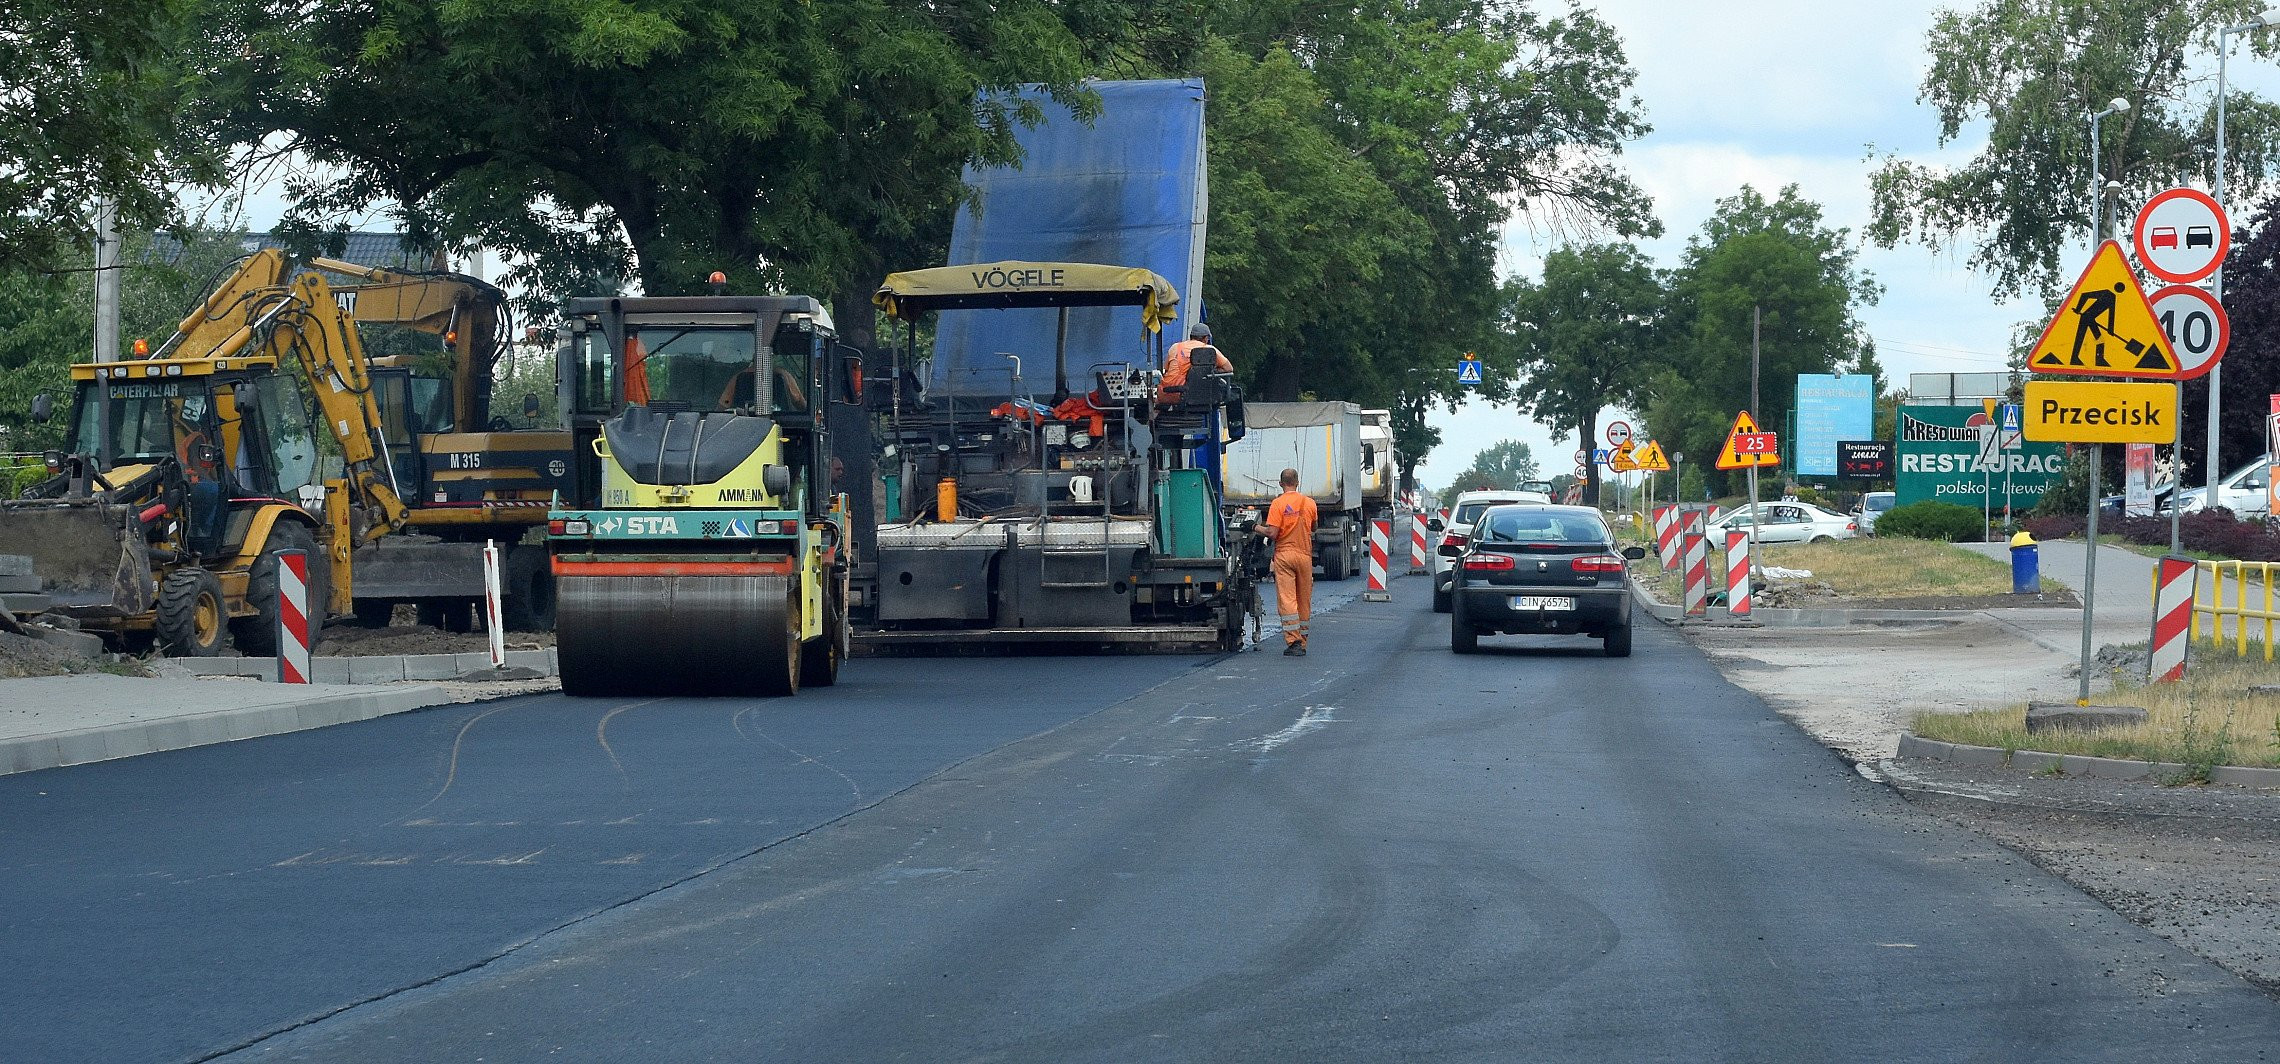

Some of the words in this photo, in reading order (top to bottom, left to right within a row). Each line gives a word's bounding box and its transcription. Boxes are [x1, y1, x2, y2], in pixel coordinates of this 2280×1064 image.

[972, 267, 1064, 289] VÖGELE
[334, 292, 356, 316] AT
[2160, 310, 2213, 354] 40
[110, 383, 178, 399] CATERPILLAR
[2042, 400, 2160, 426] Przecisk
[1747, 437, 1764, 450] 25
[450, 453, 459, 469] M
[462, 453, 480, 468] 315
[718, 489, 763, 502] AMMANN
[1935, 481, 1985, 496] polsko
[628, 517, 679, 535] STA
[1521, 597, 1539, 607] CIN
